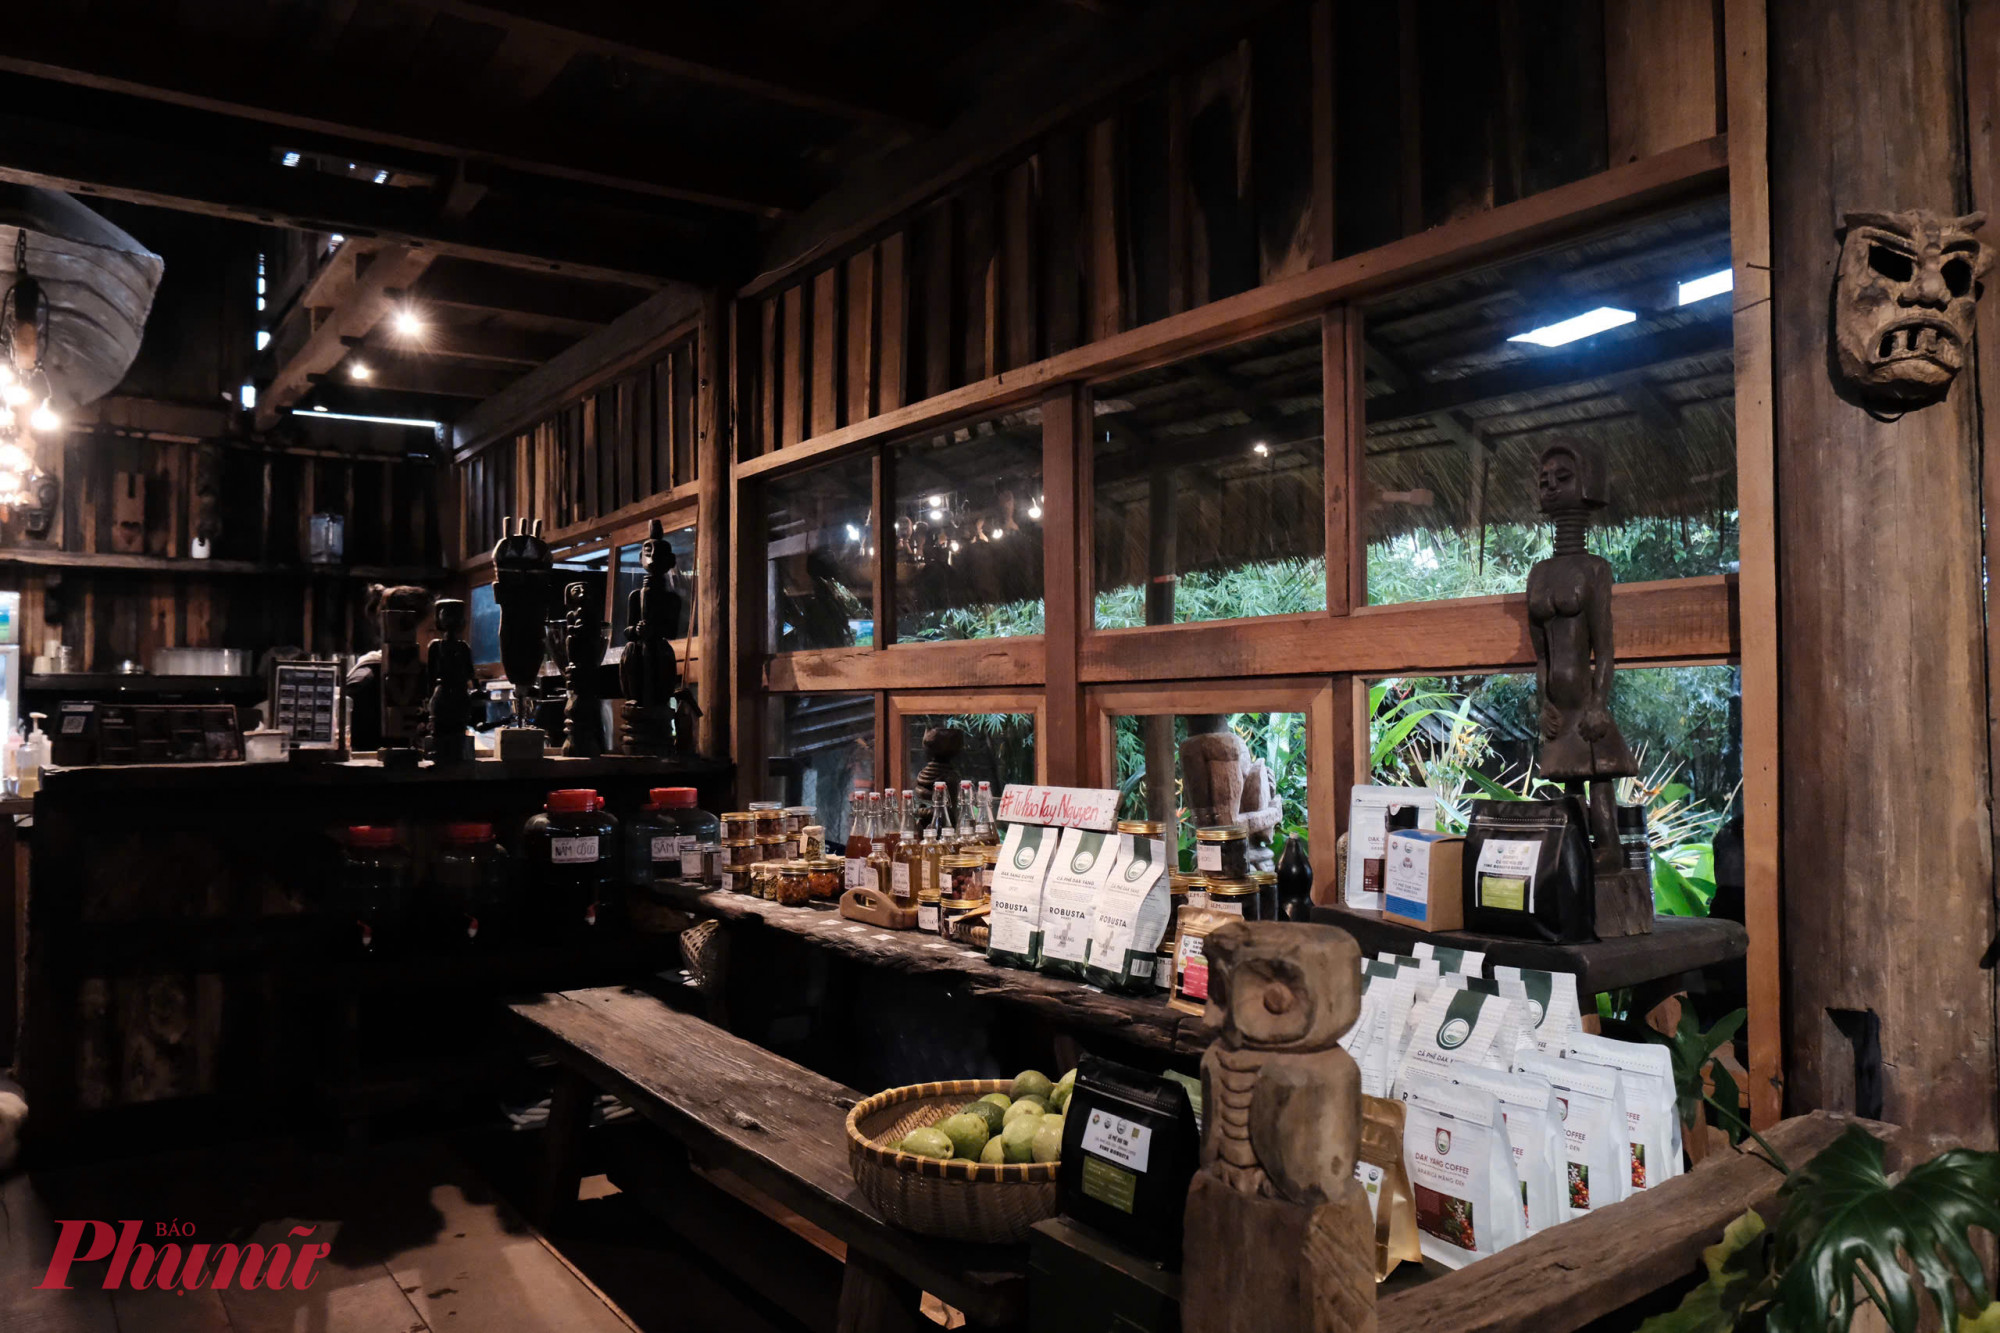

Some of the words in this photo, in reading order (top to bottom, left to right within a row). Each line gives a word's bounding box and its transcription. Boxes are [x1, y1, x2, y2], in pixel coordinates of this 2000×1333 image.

[995, 900, 1028, 913] ROBUSTA
[1049, 906, 1086, 920] ROBUSTA
[1099, 914, 1127, 928] ROBUSTA
[1415, 1152, 1428, 1162] DAK
[1430, 1157, 1444, 1168] YANG
[1444, 1162, 1470, 1176] COFFEE
